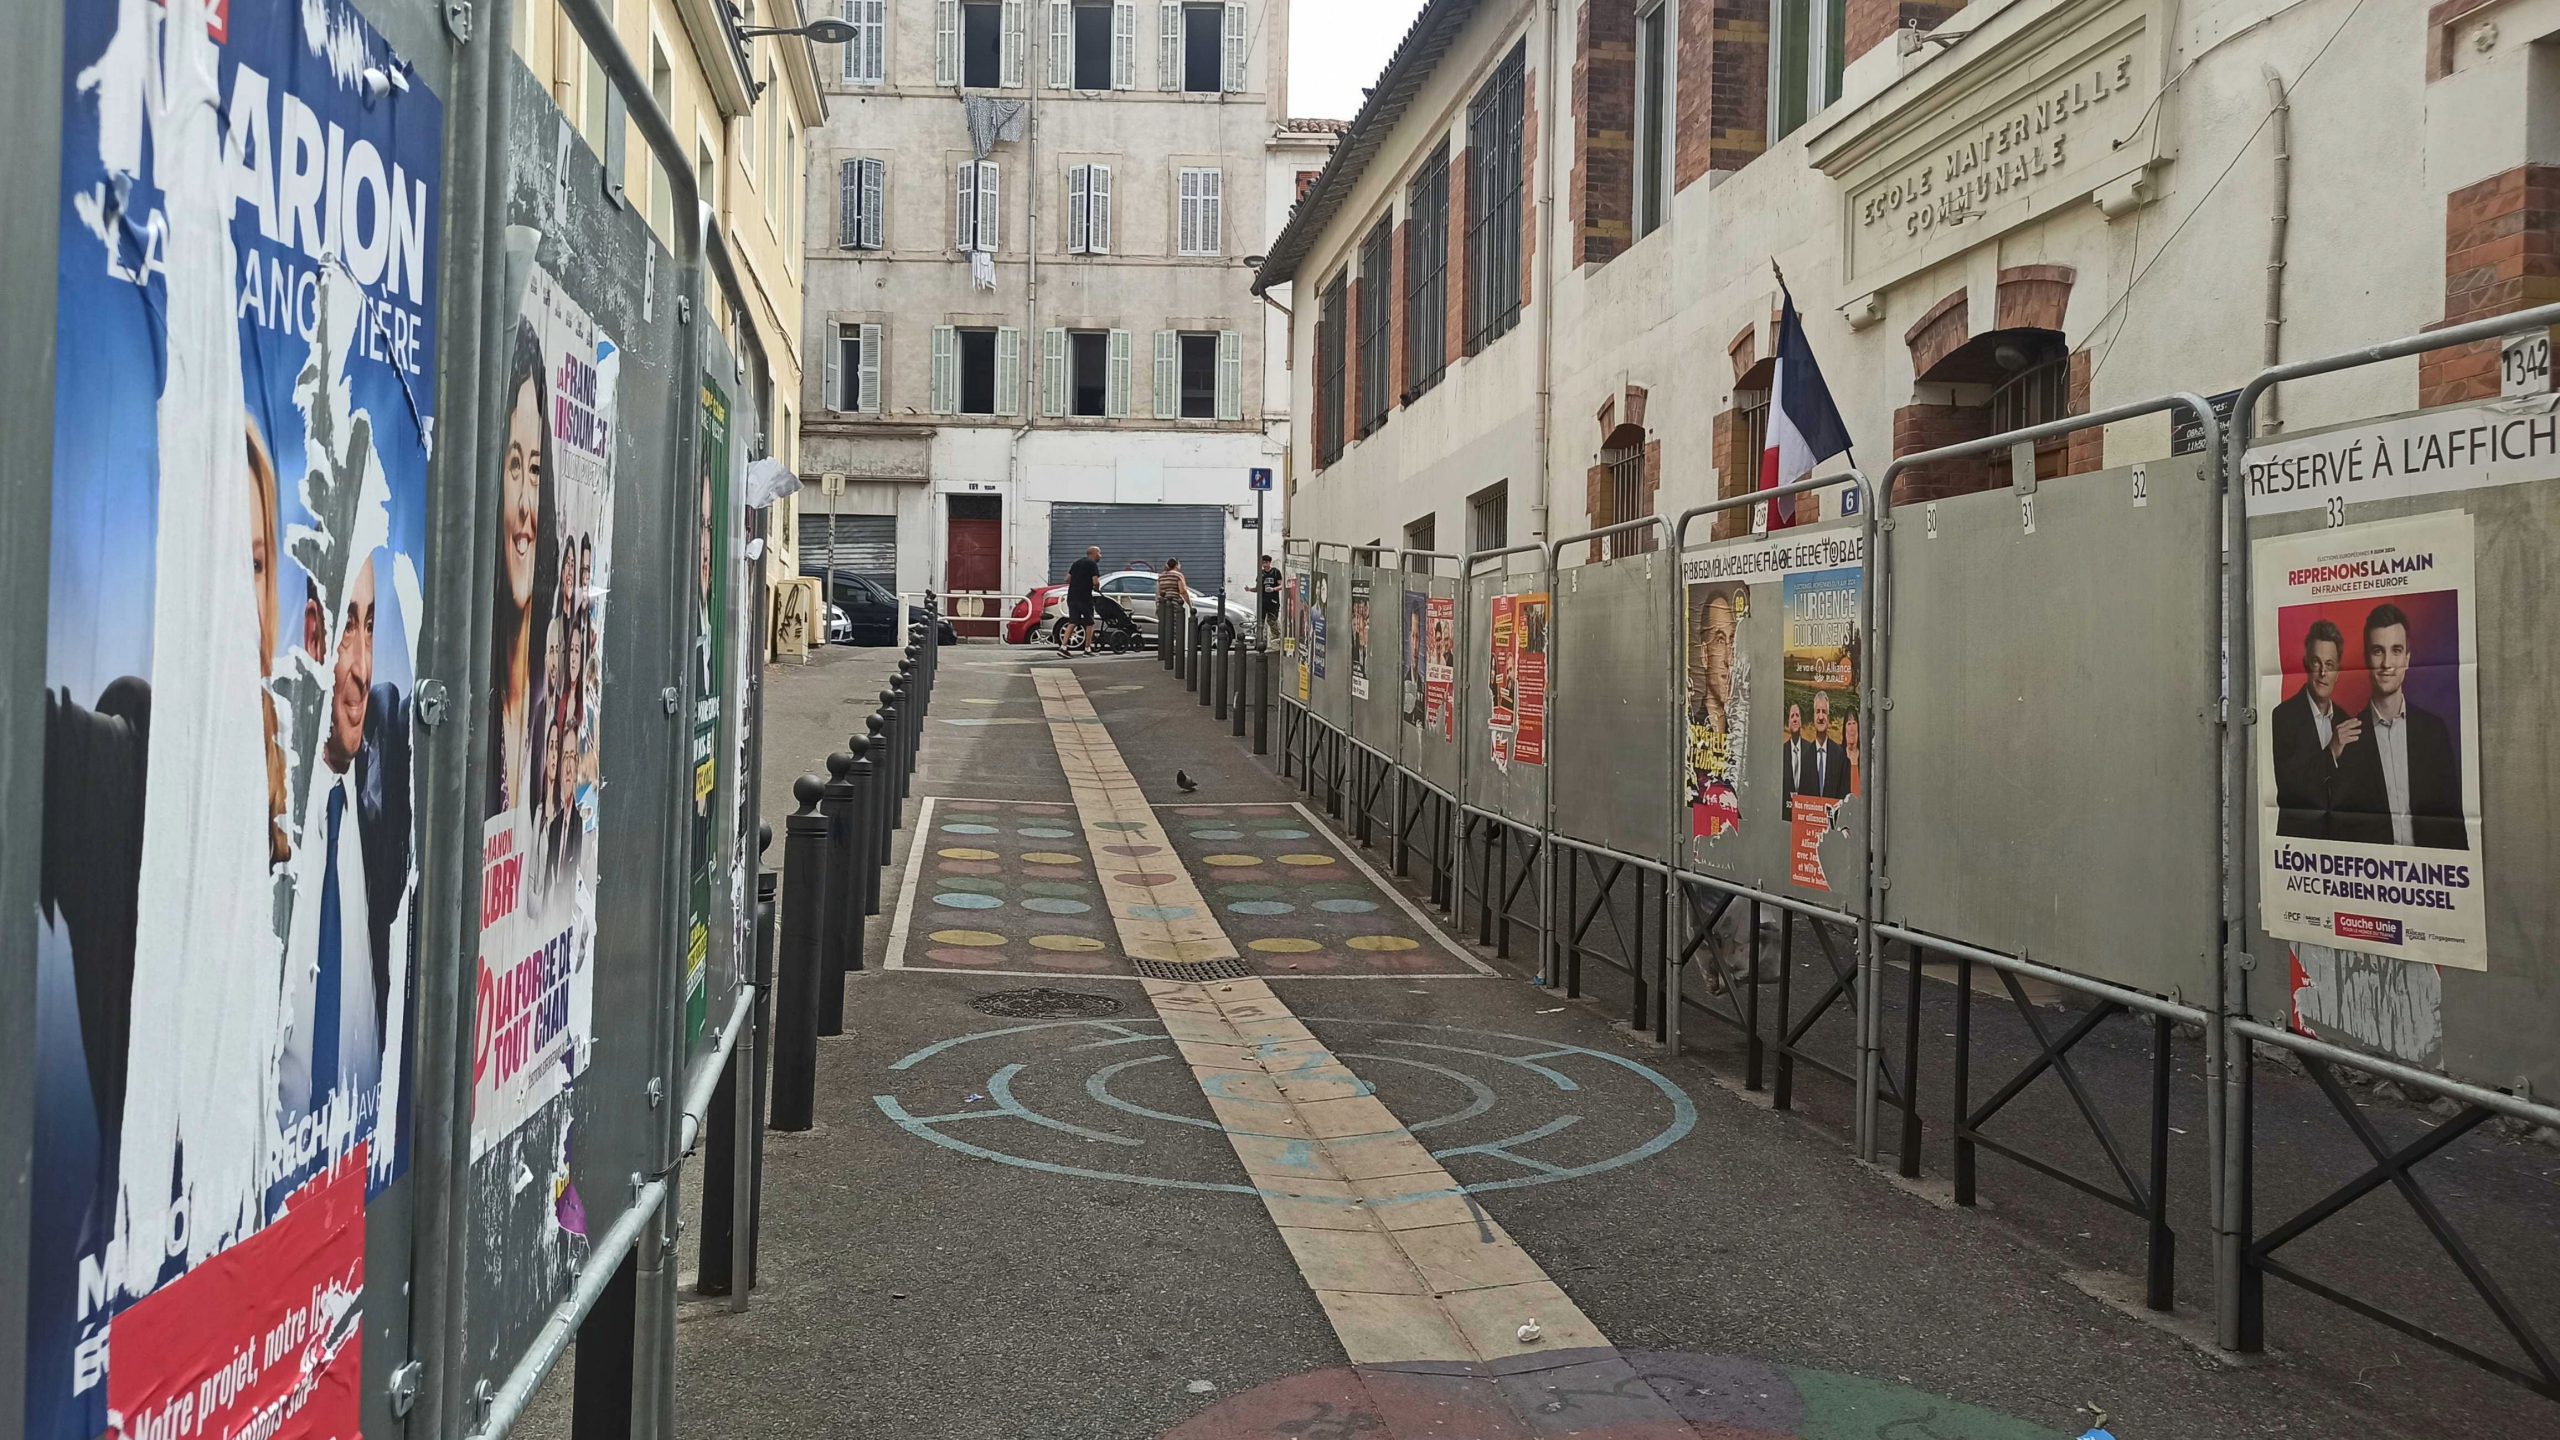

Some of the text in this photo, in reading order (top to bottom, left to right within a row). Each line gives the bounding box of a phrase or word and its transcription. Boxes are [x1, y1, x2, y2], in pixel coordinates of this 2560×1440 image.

[1864, 54, 2131, 226] ECOLE MATERNELLE
[1907, 133, 2066, 236] COMMUNALE
[2501, 338, 2549, 387] 1342
[556, 352, 597, 409] LA FRANC
[2250, 414, 2560, 496] RÉSERVÉ À L'AFFICH
[2133, 471, 2146, 499] 32
[1846, 492, 1854, 511] 6
[2022, 502, 2033, 528] 31
[2327, 496, 2344, 528] 33
[1927, 509, 1937, 532] 30
[2289, 553, 2433, 586] REPRENONS LA MAIN
[2312, 576, 2408, 595] EN FRANCE ET EN EUROPE
[1794, 589, 1856, 621] L'URGENCE
[1794, 625, 1805, 646] DU
[1807, 624, 1824, 646] BON
[1826, 662, 1851, 673] Alliance
[1804, 863, 1817, 876] Willy
[2274, 844, 2470, 888] LÉON DEFFONTAINES
[2286, 875, 2455, 910] AVEC FABIEN ROUSSEL
[2340, 916, 2373, 930] Gauche
[2375, 920, 2397, 933] Unie
[495, 970, 512, 1033] LA
[514, 938, 557, 1017] FORCE
[495, 1011, 531, 1091] TOUT
[133, 1391, 193, 1440] Notre
[196, 1335, 258, 1437] projet,
[263, 1306, 306, 1370] notre
